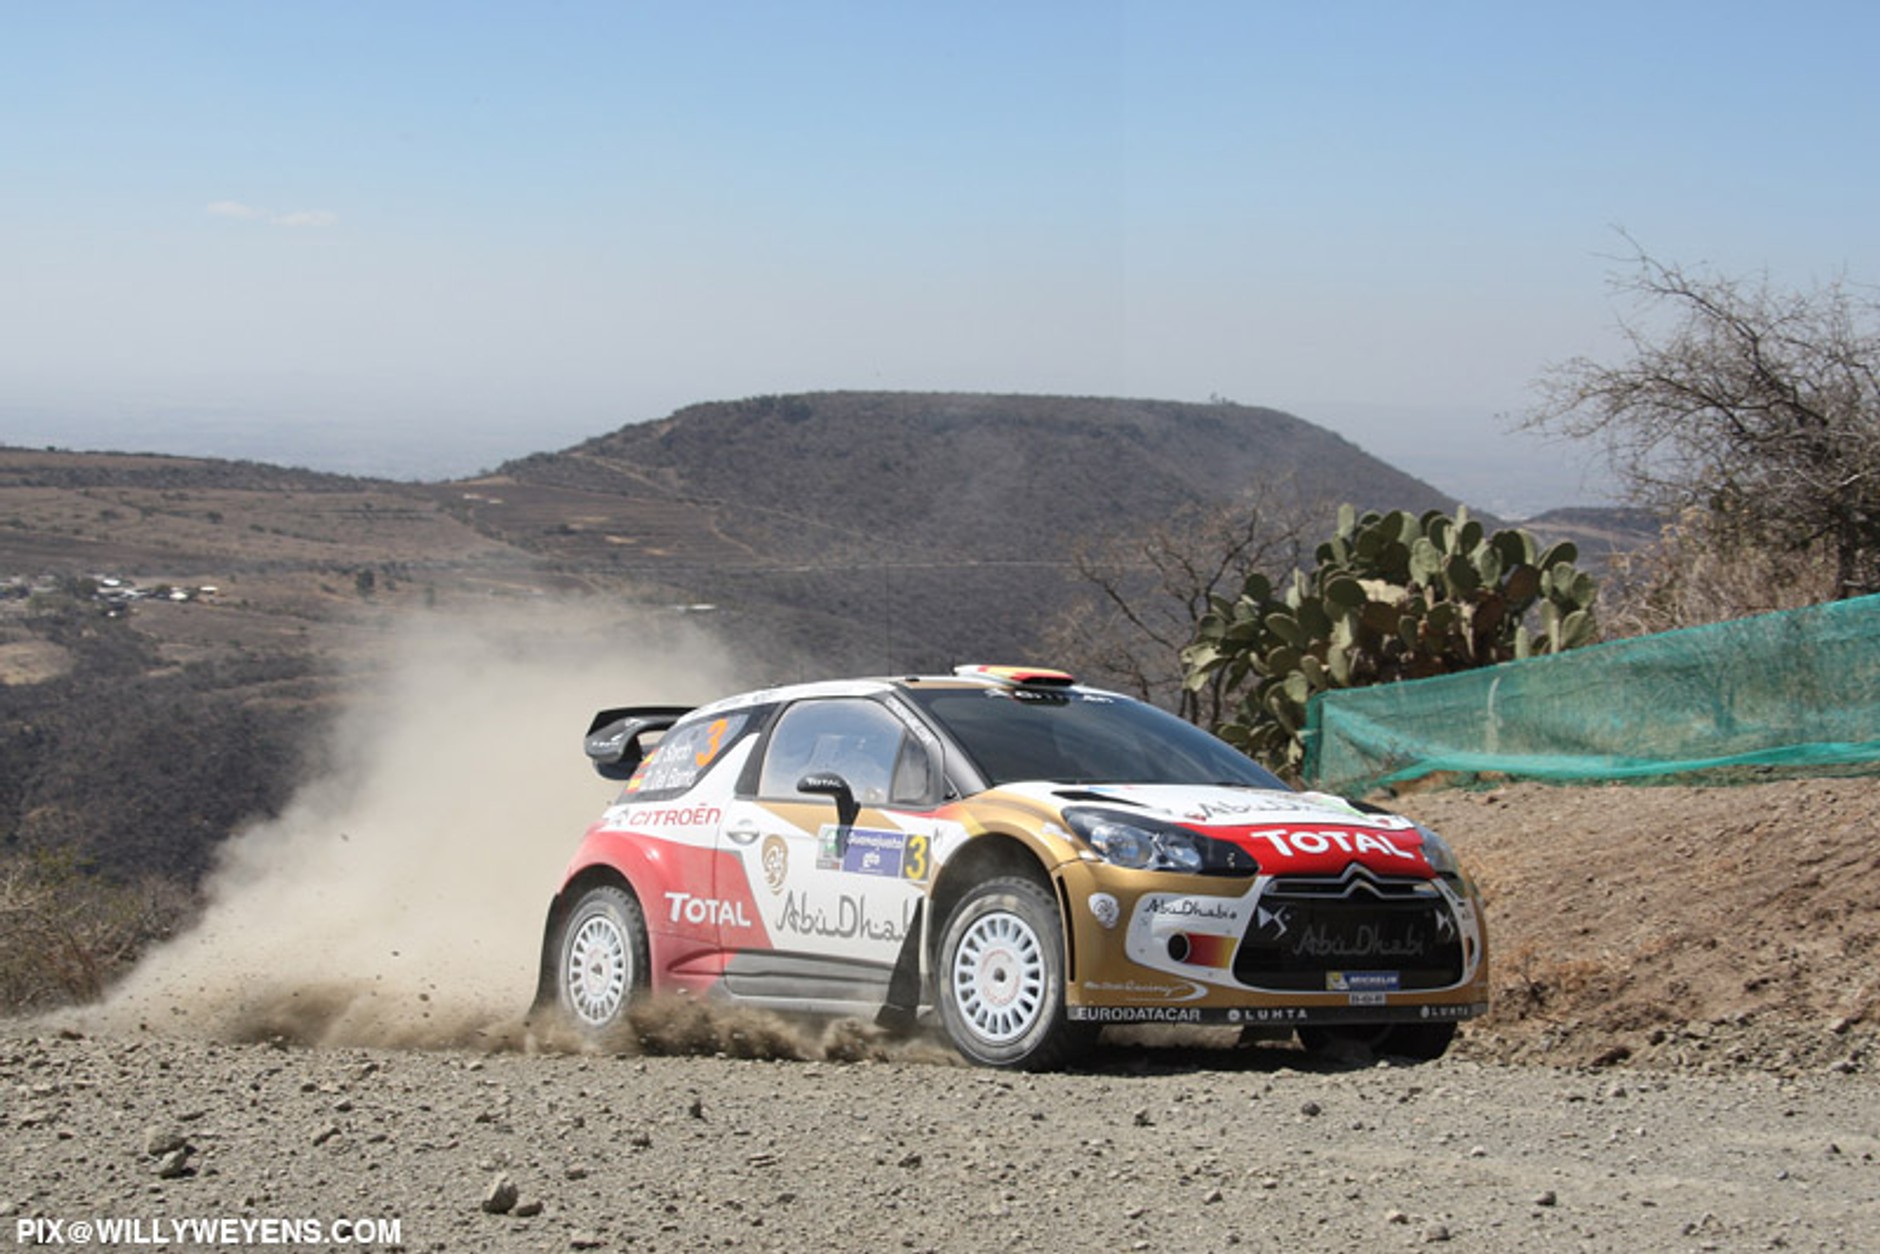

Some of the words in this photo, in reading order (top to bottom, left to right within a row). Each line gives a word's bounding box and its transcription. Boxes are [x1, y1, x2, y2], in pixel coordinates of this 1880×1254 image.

[696, 718, 728, 767] 3
[805, 777, 842, 788] TOTAL
[905, 834, 928, 881] 3
[1252, 829, 1415, 860] TOTAL
[664, 891, 752, 928] TOTAL
[1078, 1007, 1201, 1021] EURODATACAR
[1245, 1008, 1308, 1020] LUHTA
